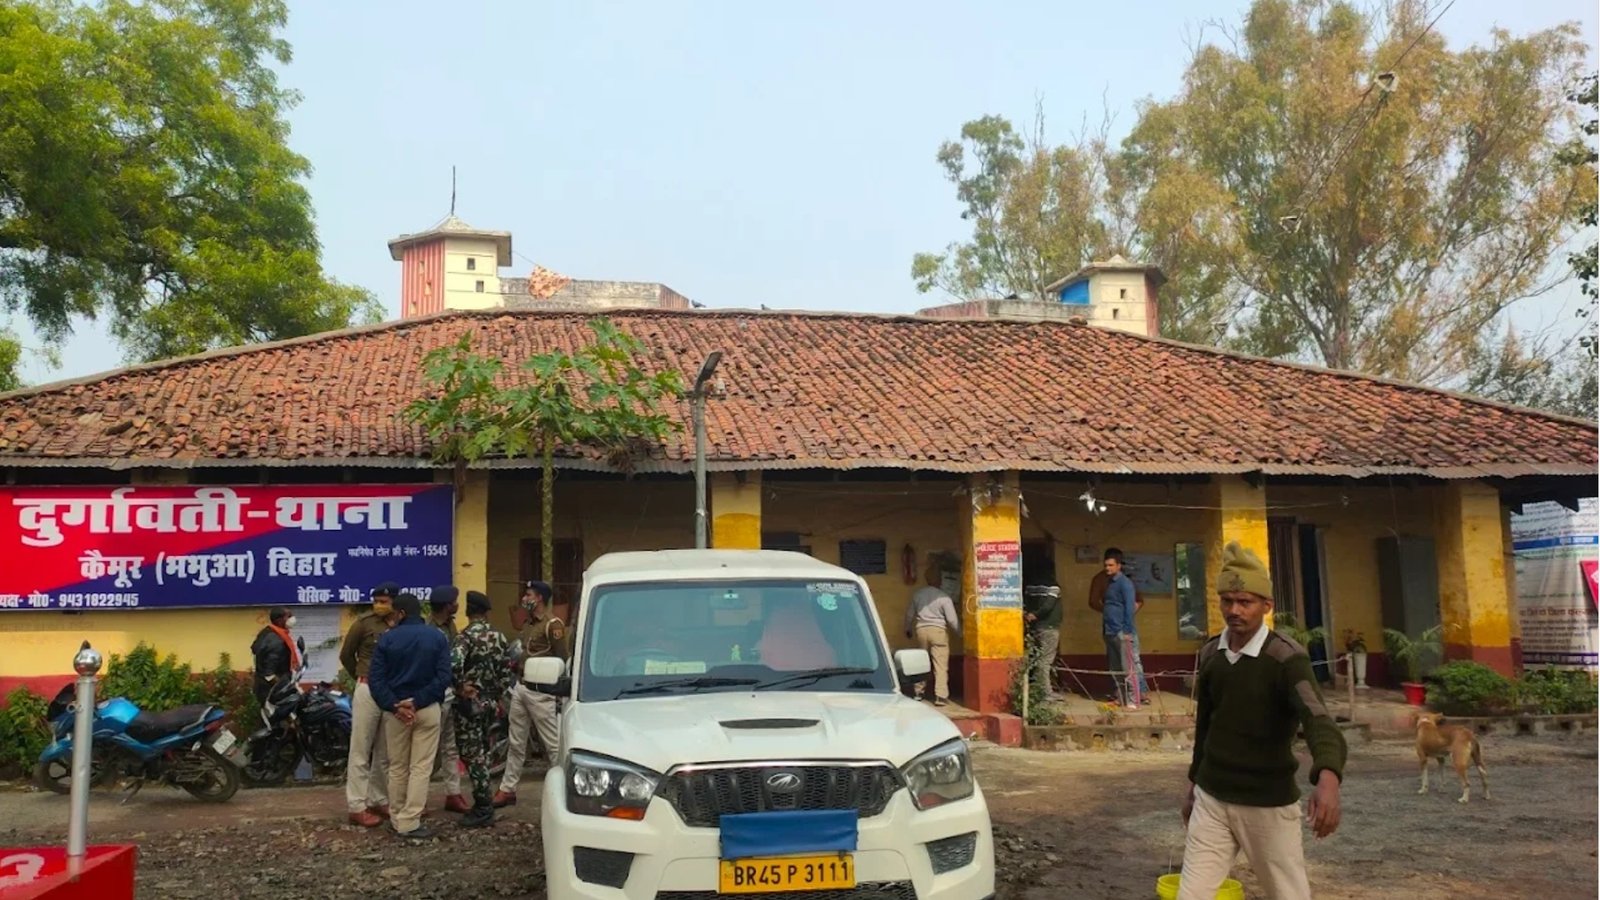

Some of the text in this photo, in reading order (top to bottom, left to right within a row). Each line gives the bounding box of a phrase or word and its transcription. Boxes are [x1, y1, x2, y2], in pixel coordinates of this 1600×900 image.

[12, 487, 413, 544] दुर्गावती-थाना
[422, 544, 448, 557] 15545
[78, 547, 338, 588] कैमूर (भभुआ) बिहार
[58, 593, 139, 607] 9431822945
[734, 862, 848, 886] BR45 P 3111
